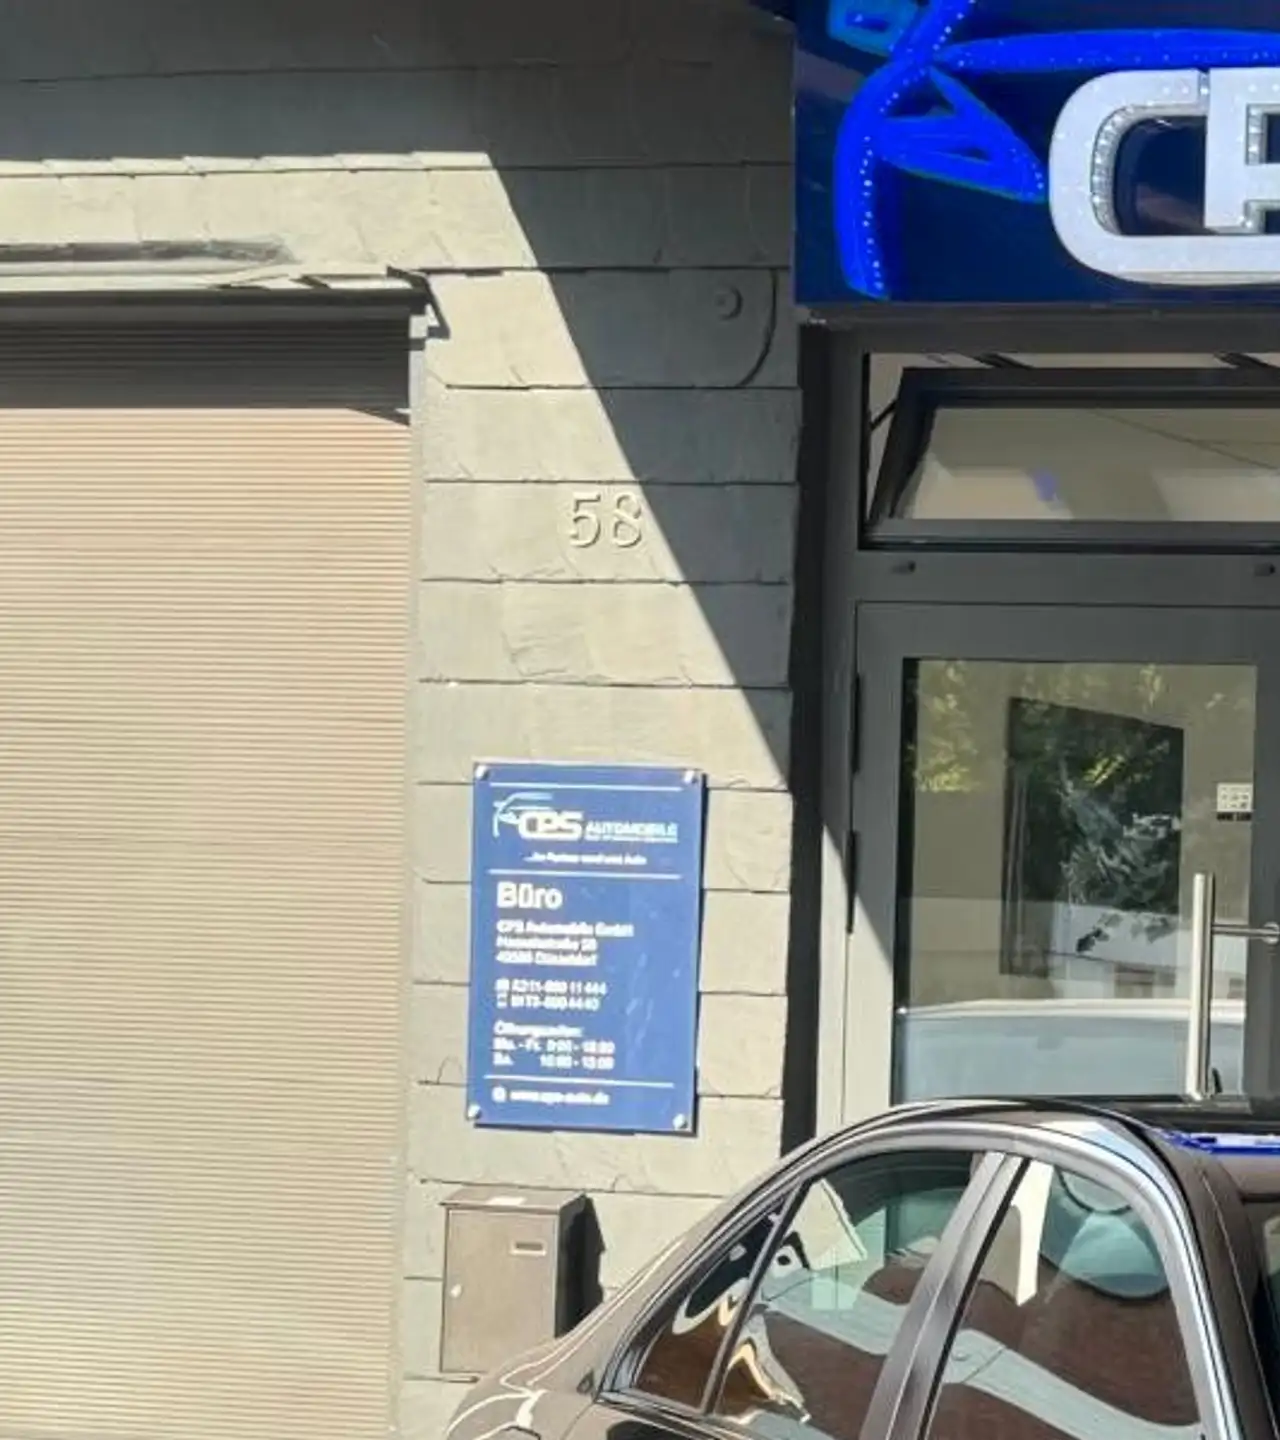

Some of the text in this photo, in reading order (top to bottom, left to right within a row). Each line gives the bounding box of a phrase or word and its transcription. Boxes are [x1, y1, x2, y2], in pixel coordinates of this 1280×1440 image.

[570, 491, 643, 549] 58
[517, 810, 584, 841] CPS
[496, 881, 563, 910] Büro
